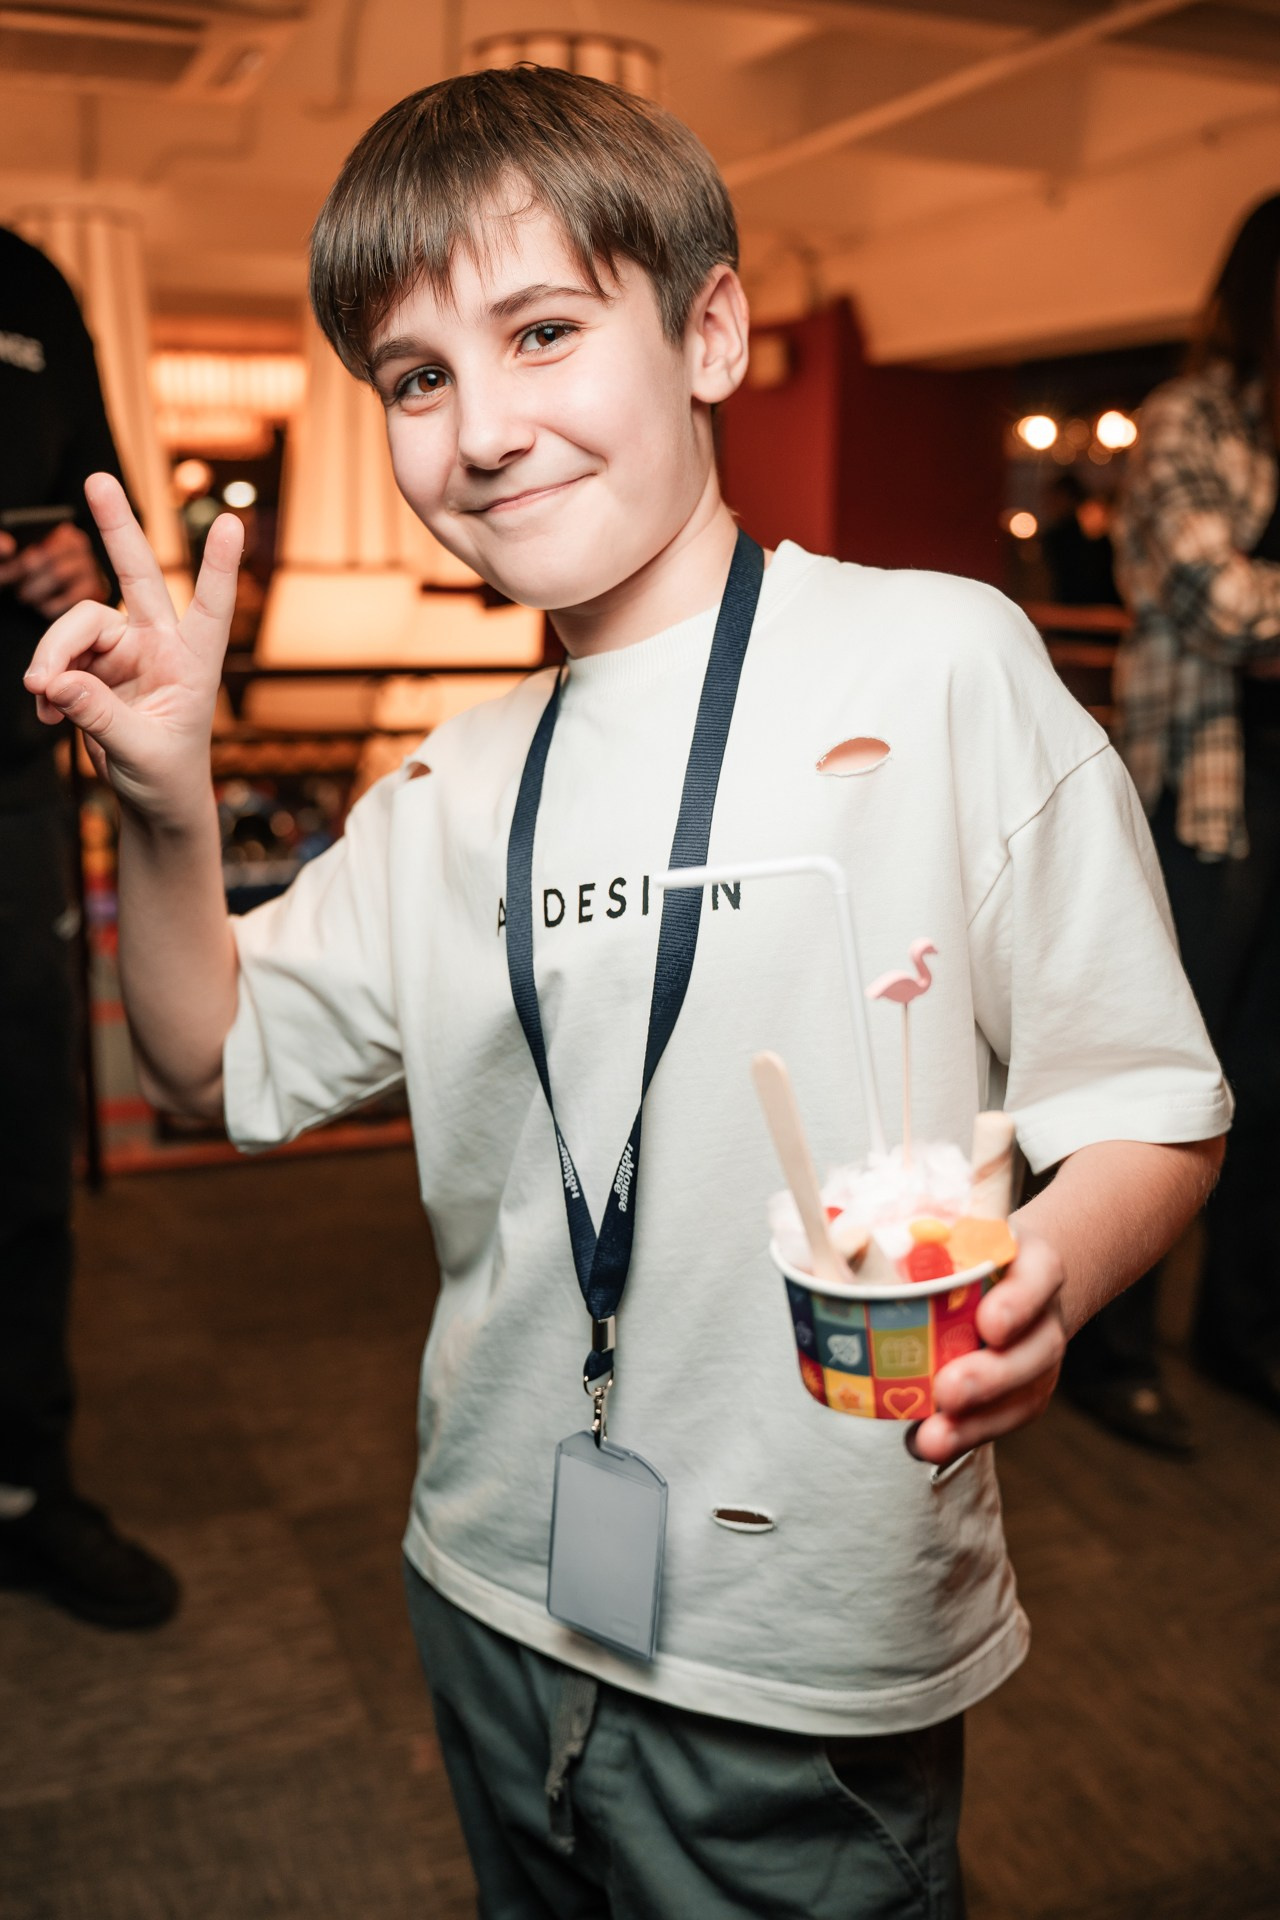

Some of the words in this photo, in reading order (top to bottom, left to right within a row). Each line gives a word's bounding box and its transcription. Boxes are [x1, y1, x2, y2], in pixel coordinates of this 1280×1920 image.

[543, 875, 741, 928] DESIN
[613, 1142, 634, 1195] House
[618, 1159, 635, 1212] Mouse
